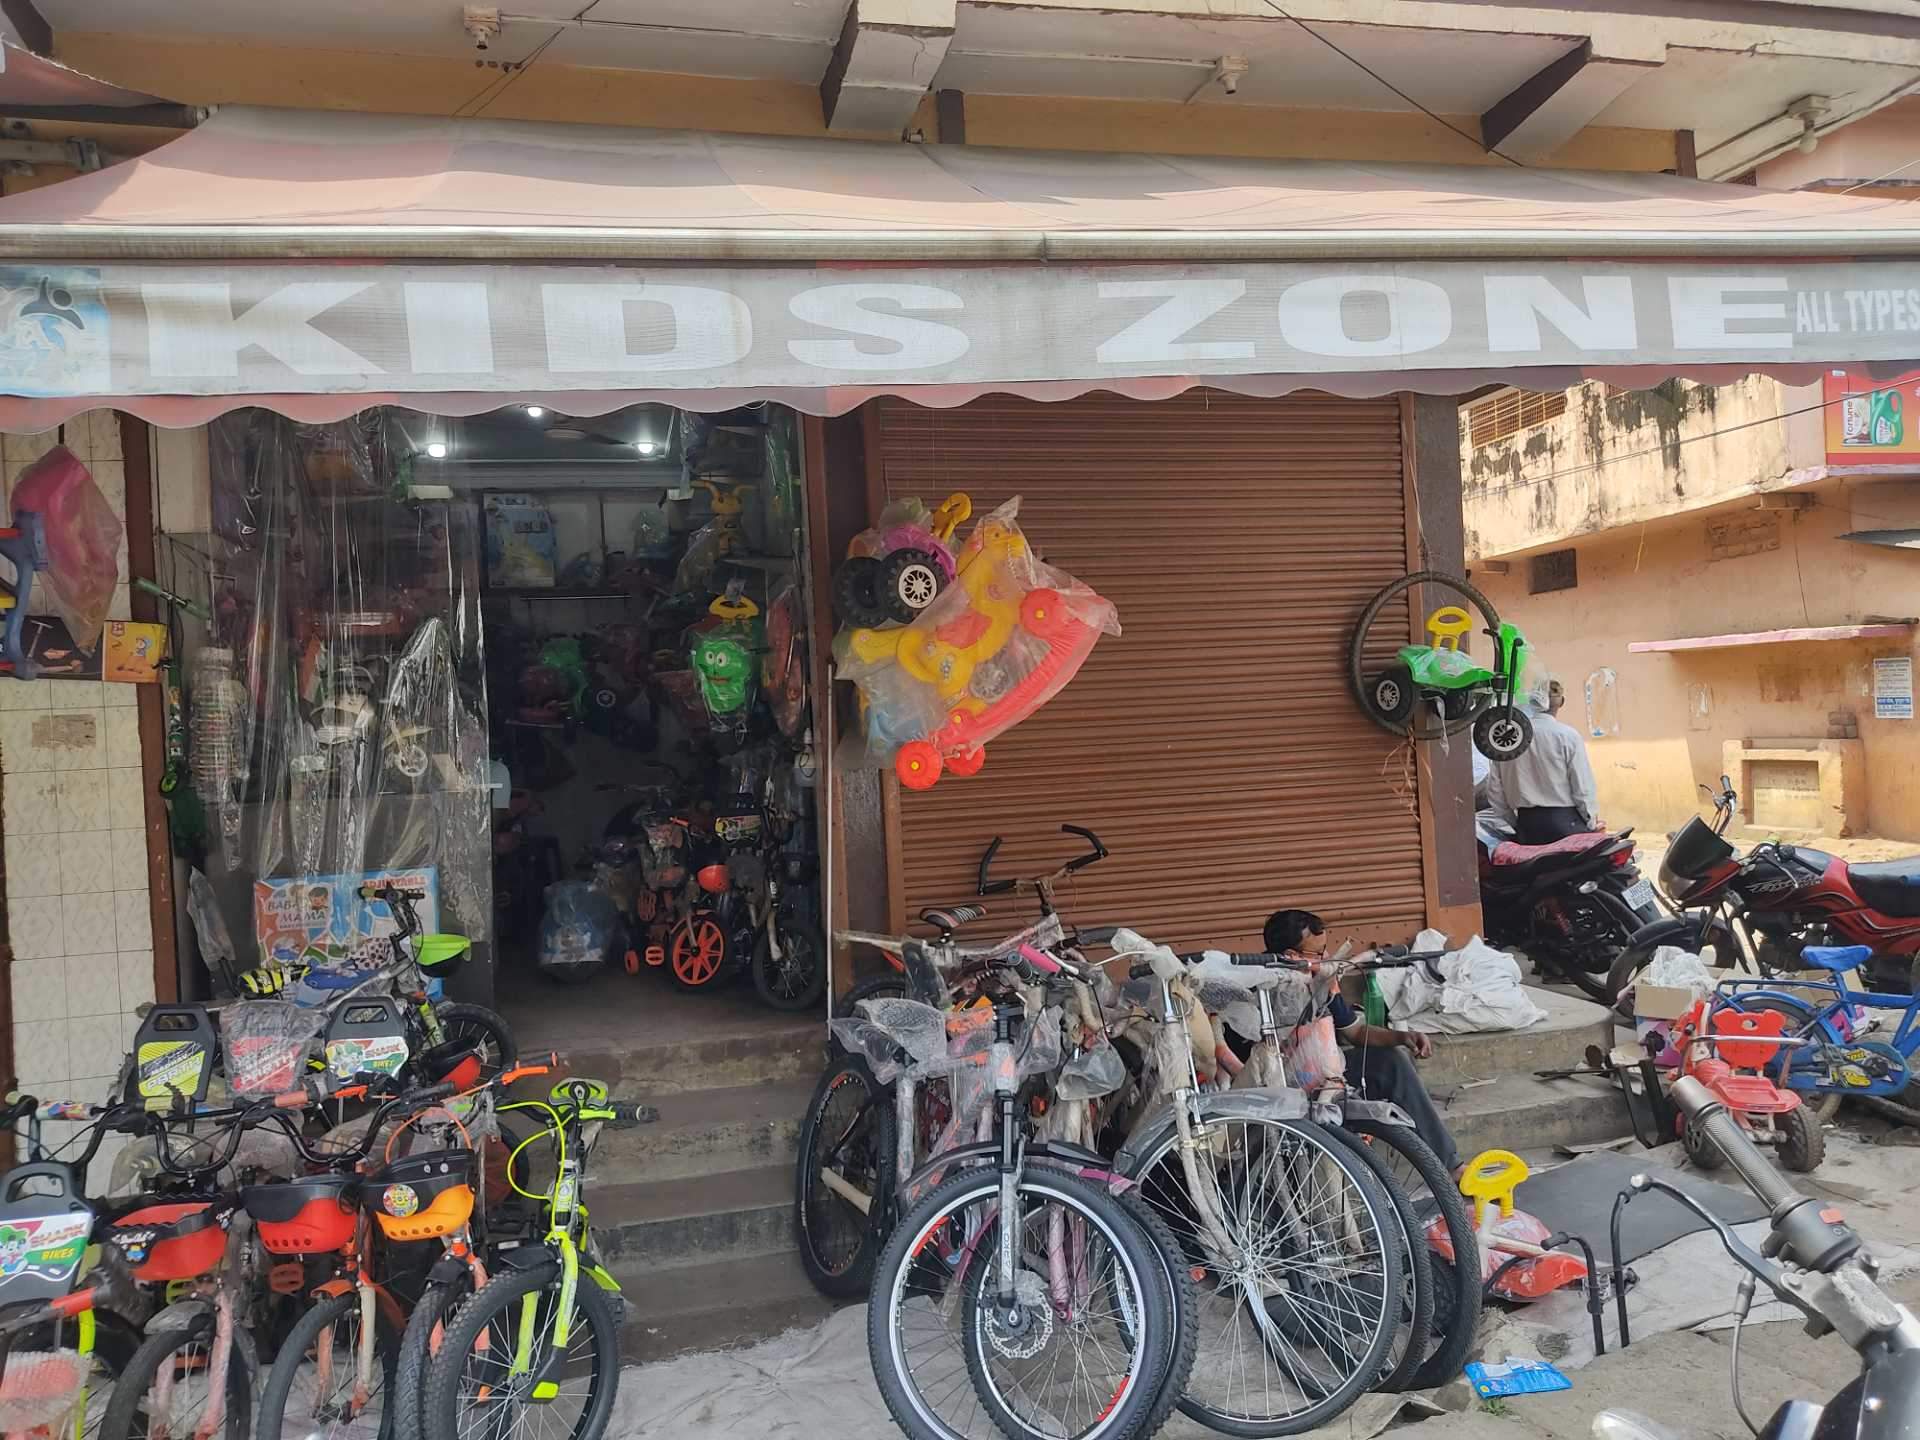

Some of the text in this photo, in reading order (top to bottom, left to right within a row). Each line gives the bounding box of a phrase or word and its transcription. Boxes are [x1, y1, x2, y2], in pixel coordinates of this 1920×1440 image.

[141, 275, 1794, 377] KIDS ZONE
[1796, 288, 1920, 332] ALL TYPES
